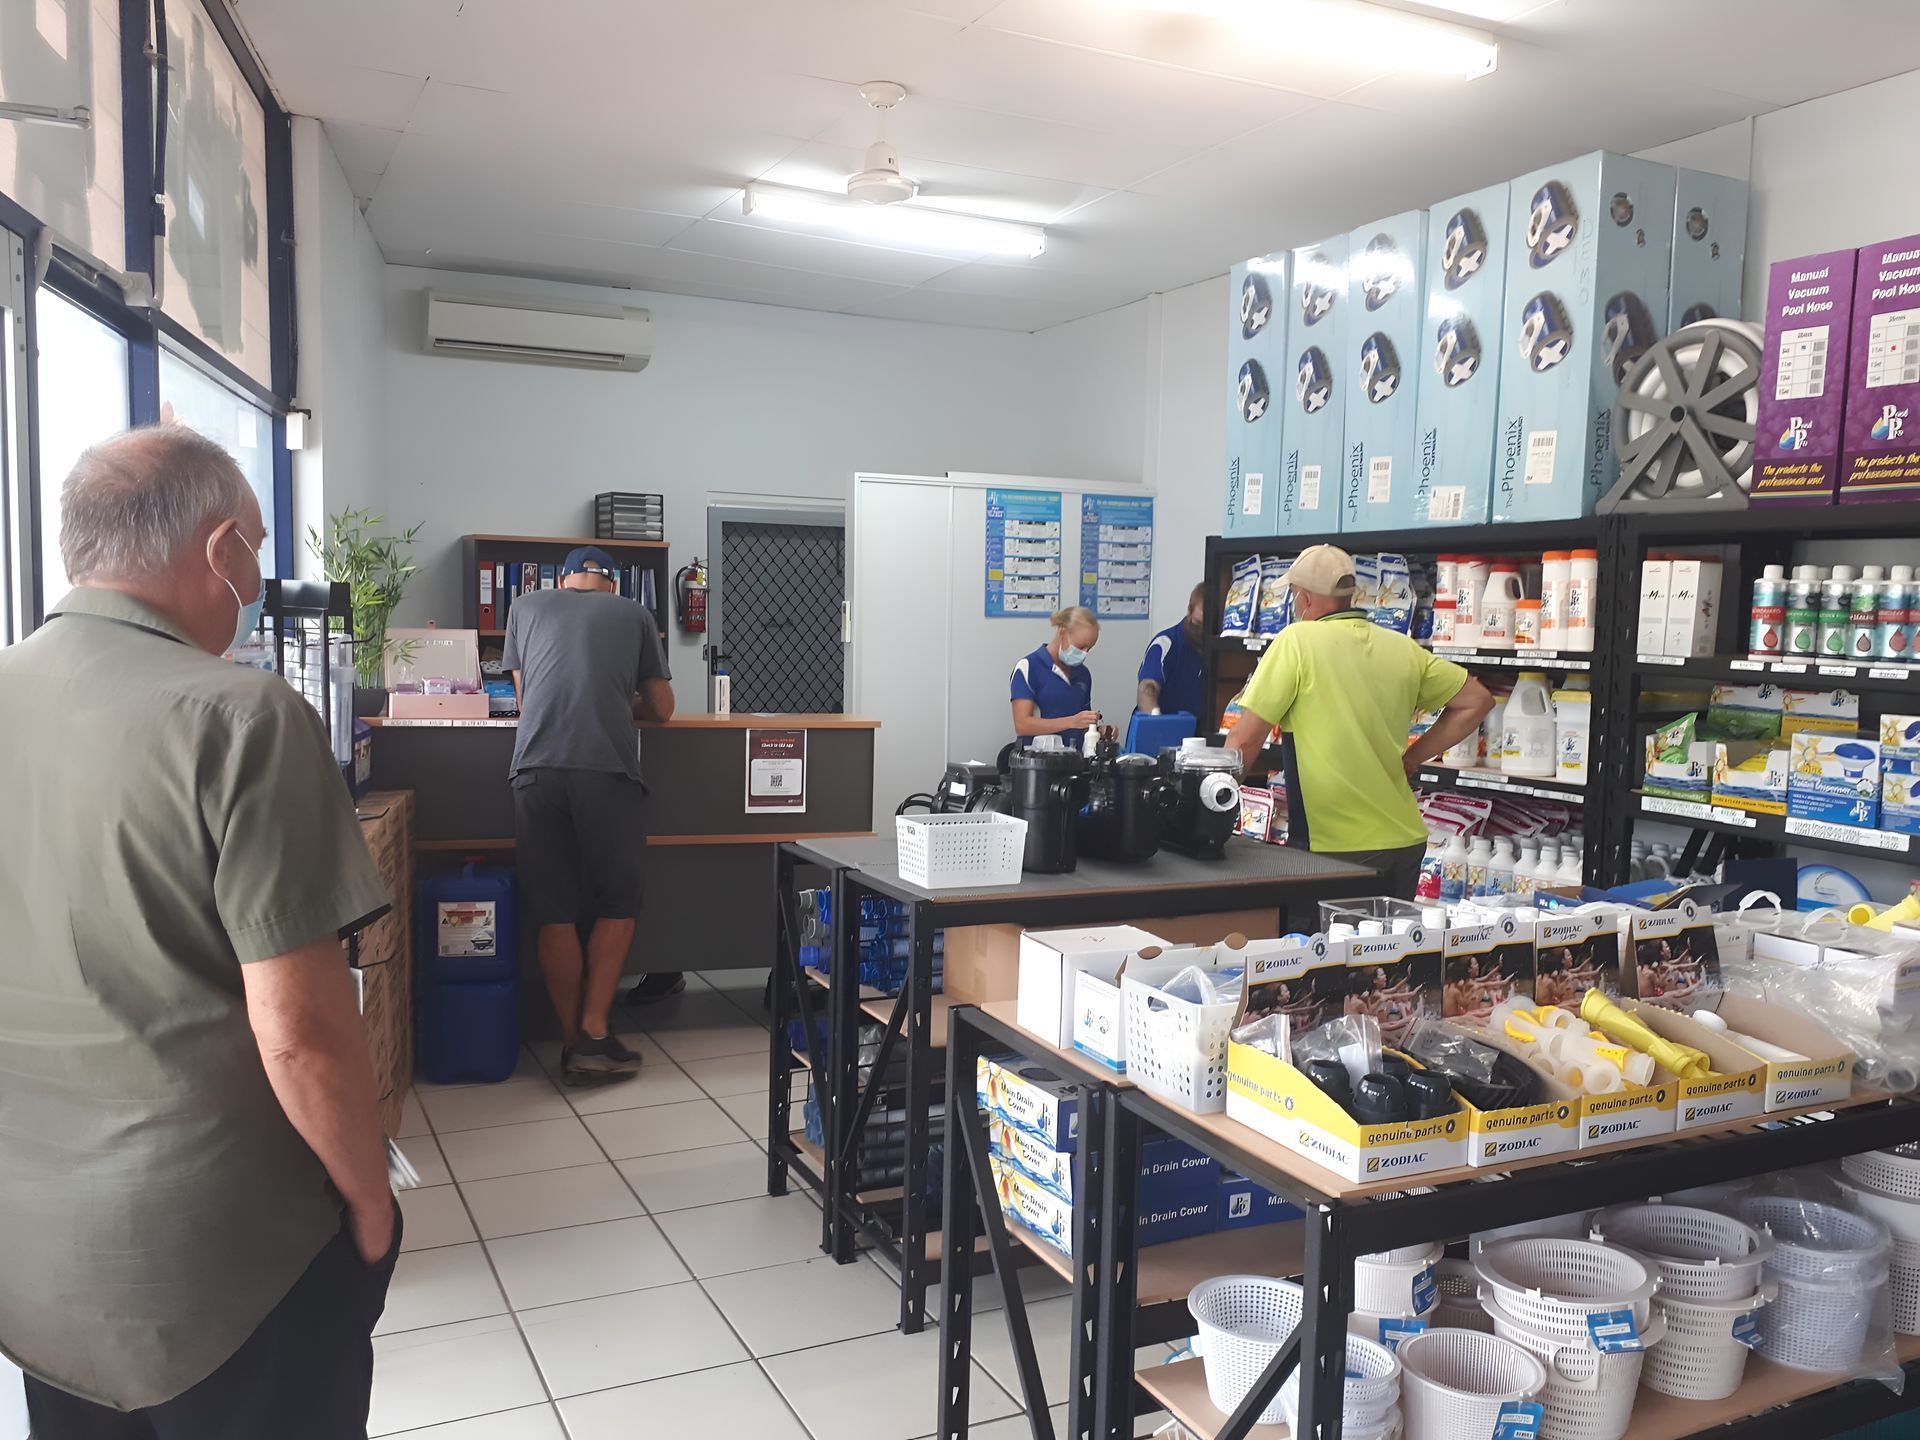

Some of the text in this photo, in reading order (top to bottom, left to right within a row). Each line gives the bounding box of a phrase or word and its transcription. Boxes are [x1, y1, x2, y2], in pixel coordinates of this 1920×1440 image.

[1882, 249, 1920, 265] Manua
[1791, 266, 1830, 284] Manual
[1788, 285, 1830, 300] Vacuum
[1872, 283, 1920, 300] Pool Hos
[1782, 301, 1833, 317] Pool Hose
[1502, 418, 1518, 492] Phoenix
[1590, 409, 1607, 486] Phoenix
[1763, 462, 1823, 476] The products the
[1854, 457, 1868, 467] The
[1866, 454, 1905, 470] products
[1284, 452, 1296, 512] Phoenix
[1348, 442, 1361, 508] Phoenix
[1757, 476, 1807, 489] professionals
[1848, 468, 1920, 483] professionals use
[1227, 459, 1238, 516] Phoenix
[1552, 925, 1583, 936] ZODIAC
[1647, 918, 1677, 927] ZODIAC
[1460, 930, 1491, 943] ZODIAC
[1363, 943, 1399, 953] ZODIAC
[1265, 957, 1302, 969] ZODIAC
[1778, 1064, 1835, 1080] genuine parts
[1001, 1081, 1035, 1109] Main Drain
[1228, 1070, 1281, 1104] genuine parts
[1686, 1079, 1746, 1096] genuine parts
[1786, 1088, 1822, 1100] ZODIAC
[1008, 1097, 1026, 1115] Cover
[1589, 1093, 1653, 1113] genuine parts
[1696, 1103, 1732, 1117] ZODIAC
[1486, 1109, 1555, 1129] genuine parts
[1368, 1123, 1443, 1144] genuine parts
[1600, 1120, 1640, 1135] ZODIAC
[1015, 1132, 1048, 1162] Main Drain
[1310, 1139, 1350, 1165] ZODIAC
[1498, 1137, 1541, 1152] ZODIAC
[1141, 1156, 1211, 1177] in Drain Cover
[1381, 1152, 1428, 1168] ZODIAC
[1014, 1183, 1048, 1214] Main Drain
[1268, 1196, 1289, 1206] Ma
[1139, 1204, 1209, 1226] in Drain Cover
